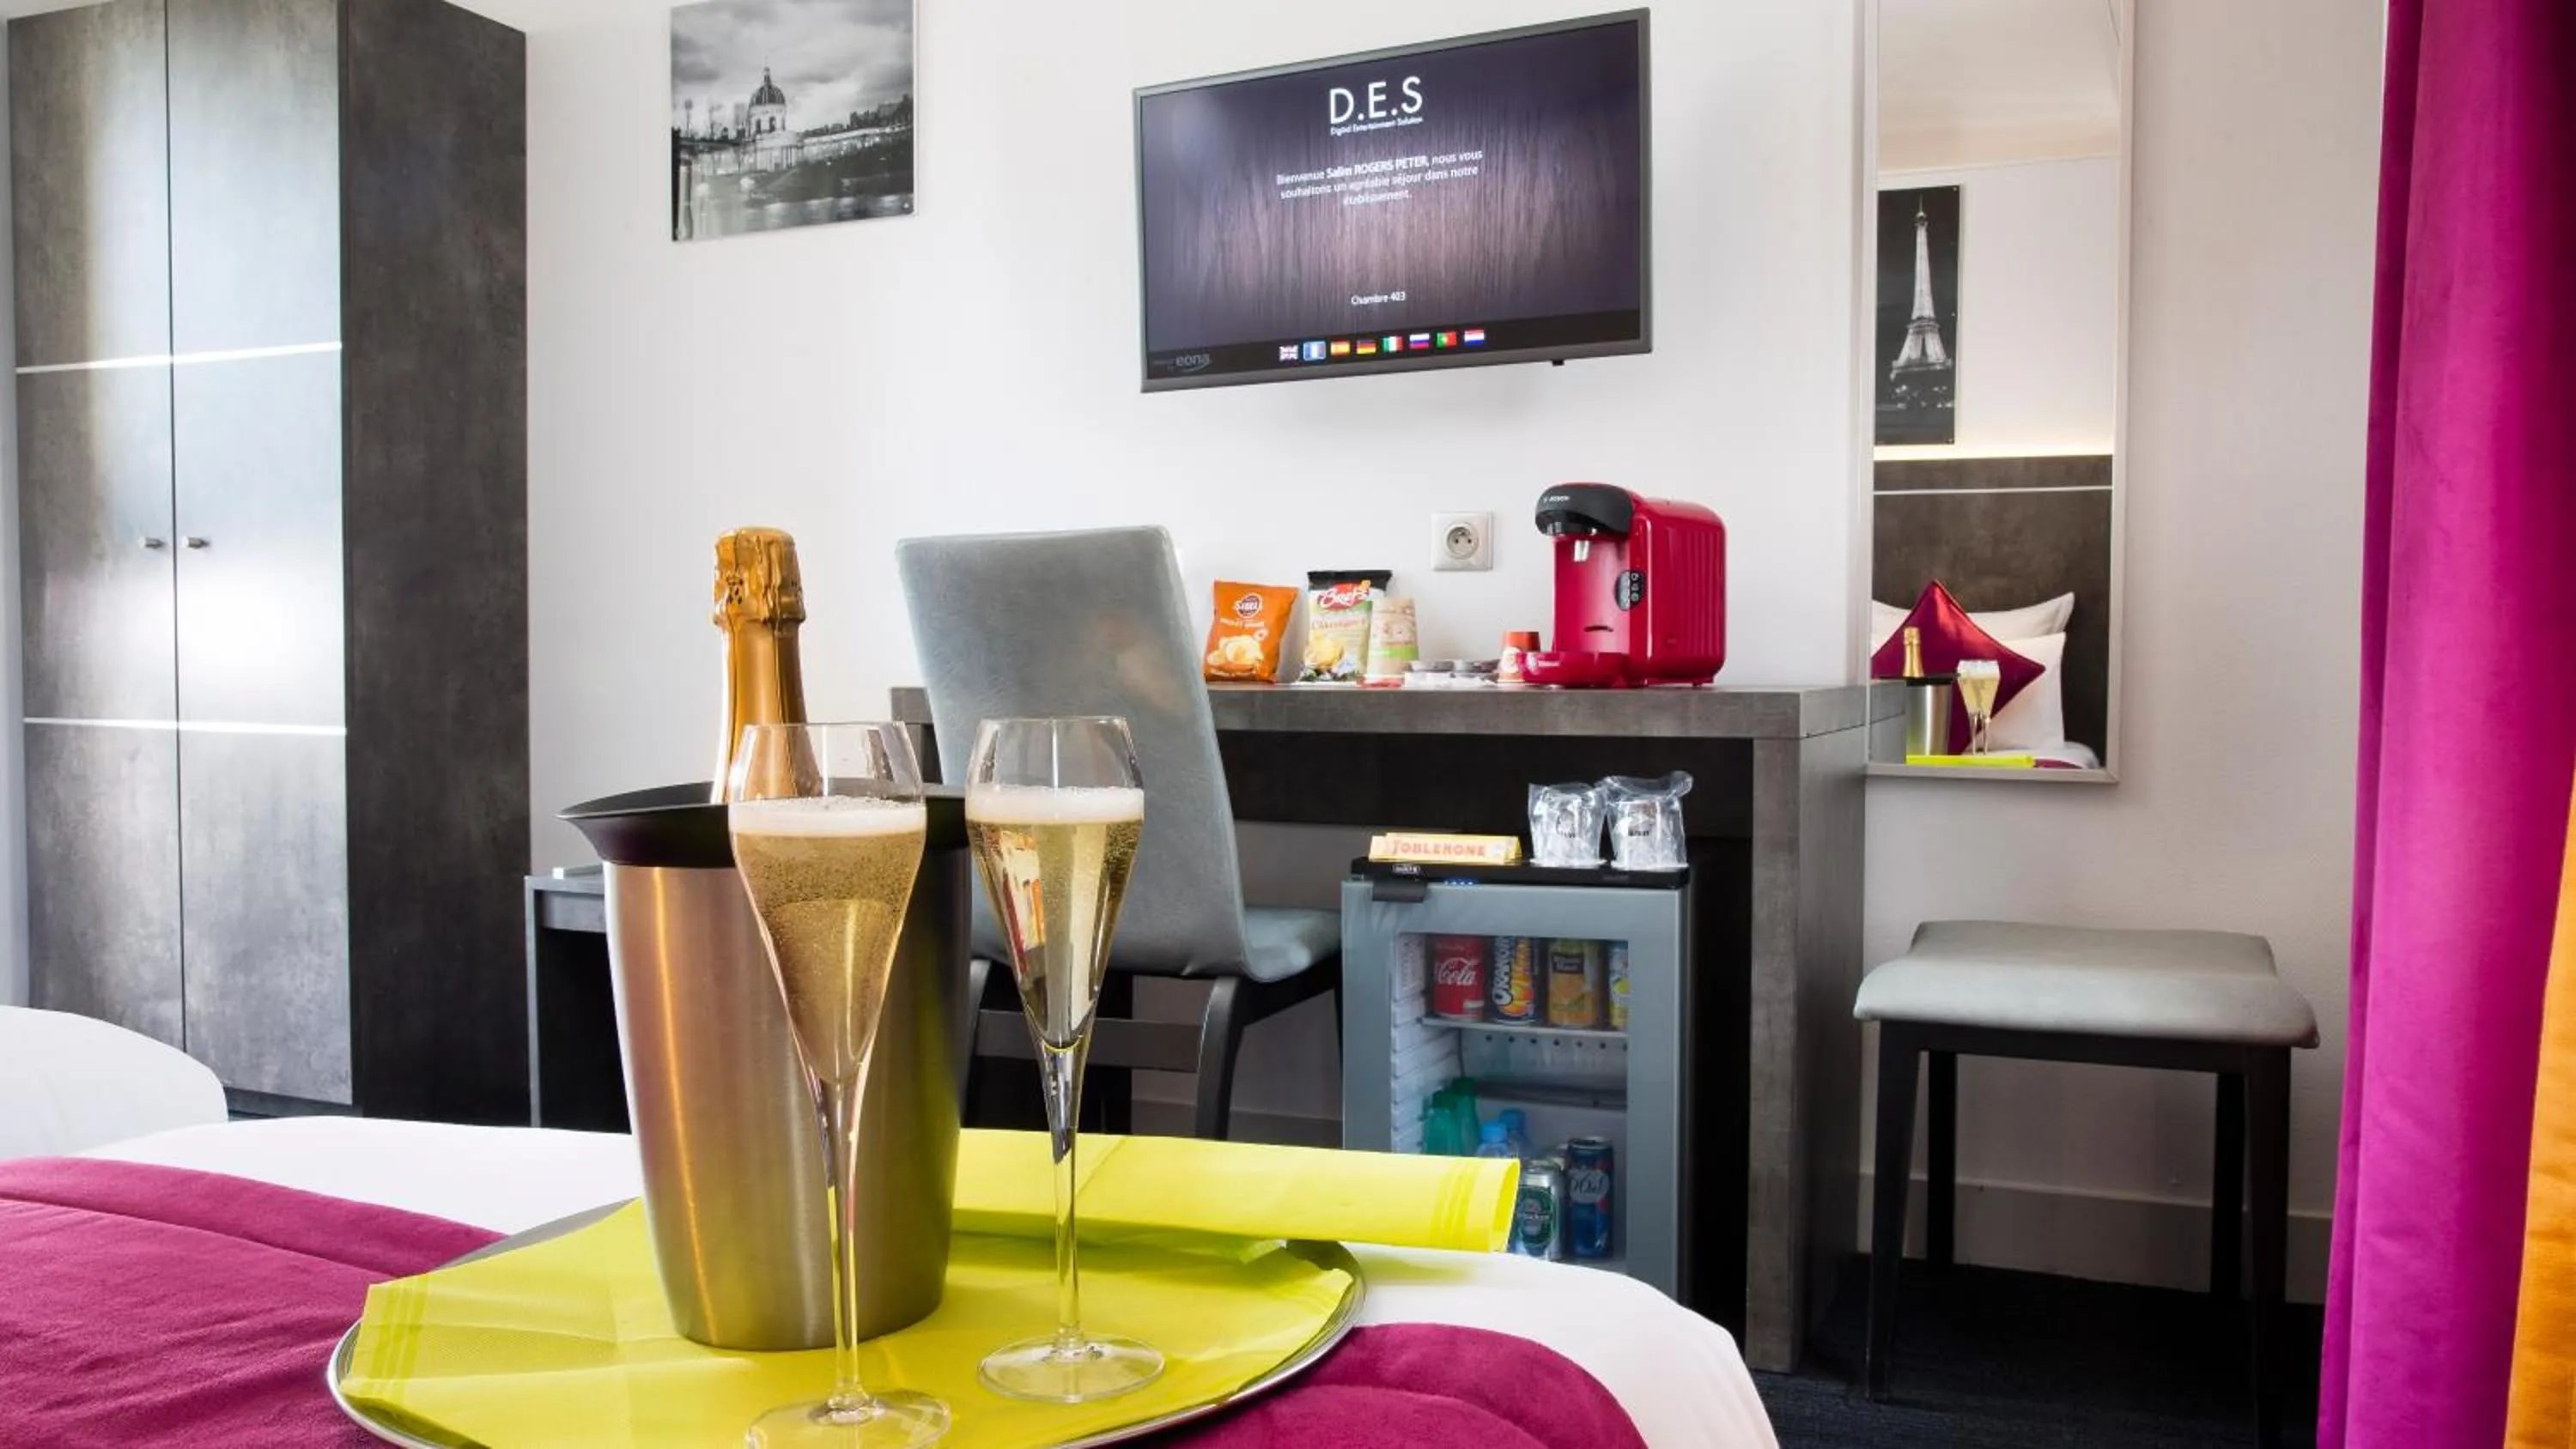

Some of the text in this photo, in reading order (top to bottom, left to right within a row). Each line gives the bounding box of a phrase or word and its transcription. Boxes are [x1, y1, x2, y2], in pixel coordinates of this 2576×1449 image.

[1329, 76, 1423, 124] D.E.S
[1276, 171, 1325, 185] Bienvenue
[1354, 160, 1394, 175] ROGERS
[1431, 153, 1457, 166] nous
[1458, 149, 1483, 162] vous
[1280, 184, 1333, 200] souhaitons
[1334, 182, 1347, 193] un
[1391, 172, 1423, 186] séjour
[1425, 169, 1449, 181] dans
[1450, 165, 1479, 179] notre
[1351, 294, 1388, 305] Chambre
[1392, 839, 1486, 857] TOBLERONE
